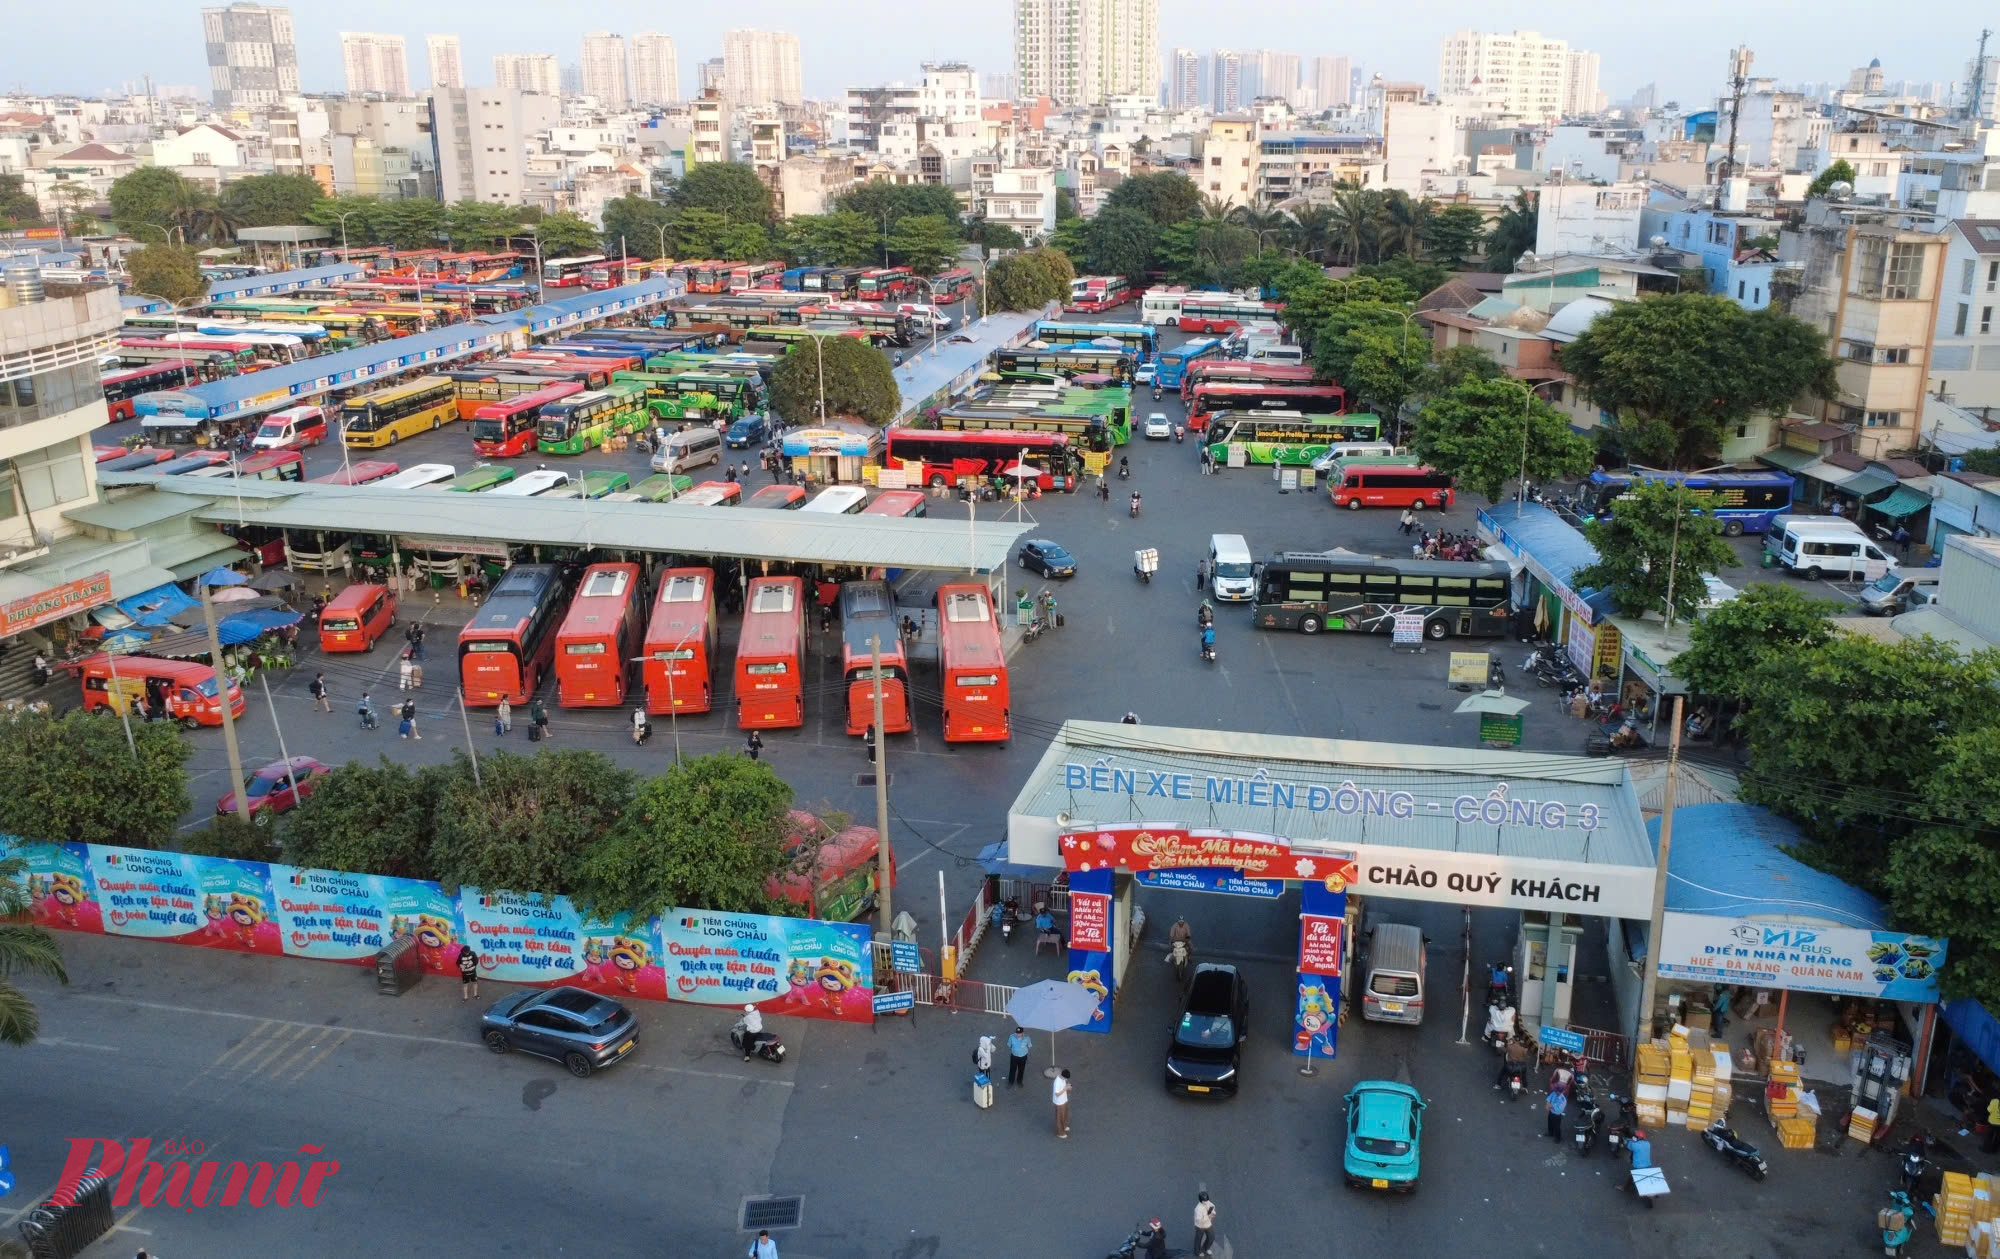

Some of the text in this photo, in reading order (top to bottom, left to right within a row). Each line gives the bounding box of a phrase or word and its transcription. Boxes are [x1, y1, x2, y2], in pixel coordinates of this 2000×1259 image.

[64, 582, 105, 603] TRANG
[1065, 755, 1599, 831] BẾN XE MIỀN ĐÔNG - CỔNG 3
[124, 855, 142, 863] TIÊM
[126, 864, 183, 877] LONG CHÂU
[1175, 872, 1197, 880] THUỐC
[309, 875, 326, 884] TIÊM
[1160, 879, 1205, 889] LONG CHÂU
[1228, 878, 1243, 886] TIÊM
[1368, 864, 1600, 902] CHÀO QUÝ KHÁCH
[98, 877, 136, 893] Chuyên
[161, 883, 196, 897] chuẩn
[310, 885, 369, 898] LONG CHÂU
[1228, 885, 1273, 895] LONG CHÂU
[110, 895, 134, 907] Dịch
[136, 897, 148, 907] vụ
[280, 899, 320, 914] Chuyên
[346, 904, 383, 918] chuẩn
[501, 906, 562, 920] LONG CHÂU
[149, 910, 177, 924] tuyệt
[293, 916, 317, 929] Dịch
[319, 918, 332, 929] vụ
[702, 917, 757, 929] TIÊM CHỦNG
[467, 920, 510, 936] Chuyên
[537, 925, 576, 940] chuẩn
[703, 927, 768, 941] LONG CHÂU
[1311, 921, 1329, 934] Tết
[332, 931, 361, 946] tuyệt
[1763, 928, 1820, 947] MP
[480, 938, 507, 952] Dịch
[508, 941, 522, 952] vụ
[667, 942, 780, 962] Chuyên môn chuẩn
[1801, 944, 1832, 954] BUS
[522, 954, 552, 969] tuyệt
[1753, 949, 1800, 962] NHẬN
[1805, 954, 1852, 967] HÀNG
[680, 960, 775, 976] Dịch vụ tận tâm
[1690, 956, 1714, 967] HUẾ
[1791, 964, 1833, 977] QUẢNG
[1836, 971, 1864, 980] NAM
[695, 975, 720, 986] toàn
[722, 976, 755, 991] tuyệt
[757, 978, 778, 992] đối
[1306, 1018, 1311, 1028] 5
